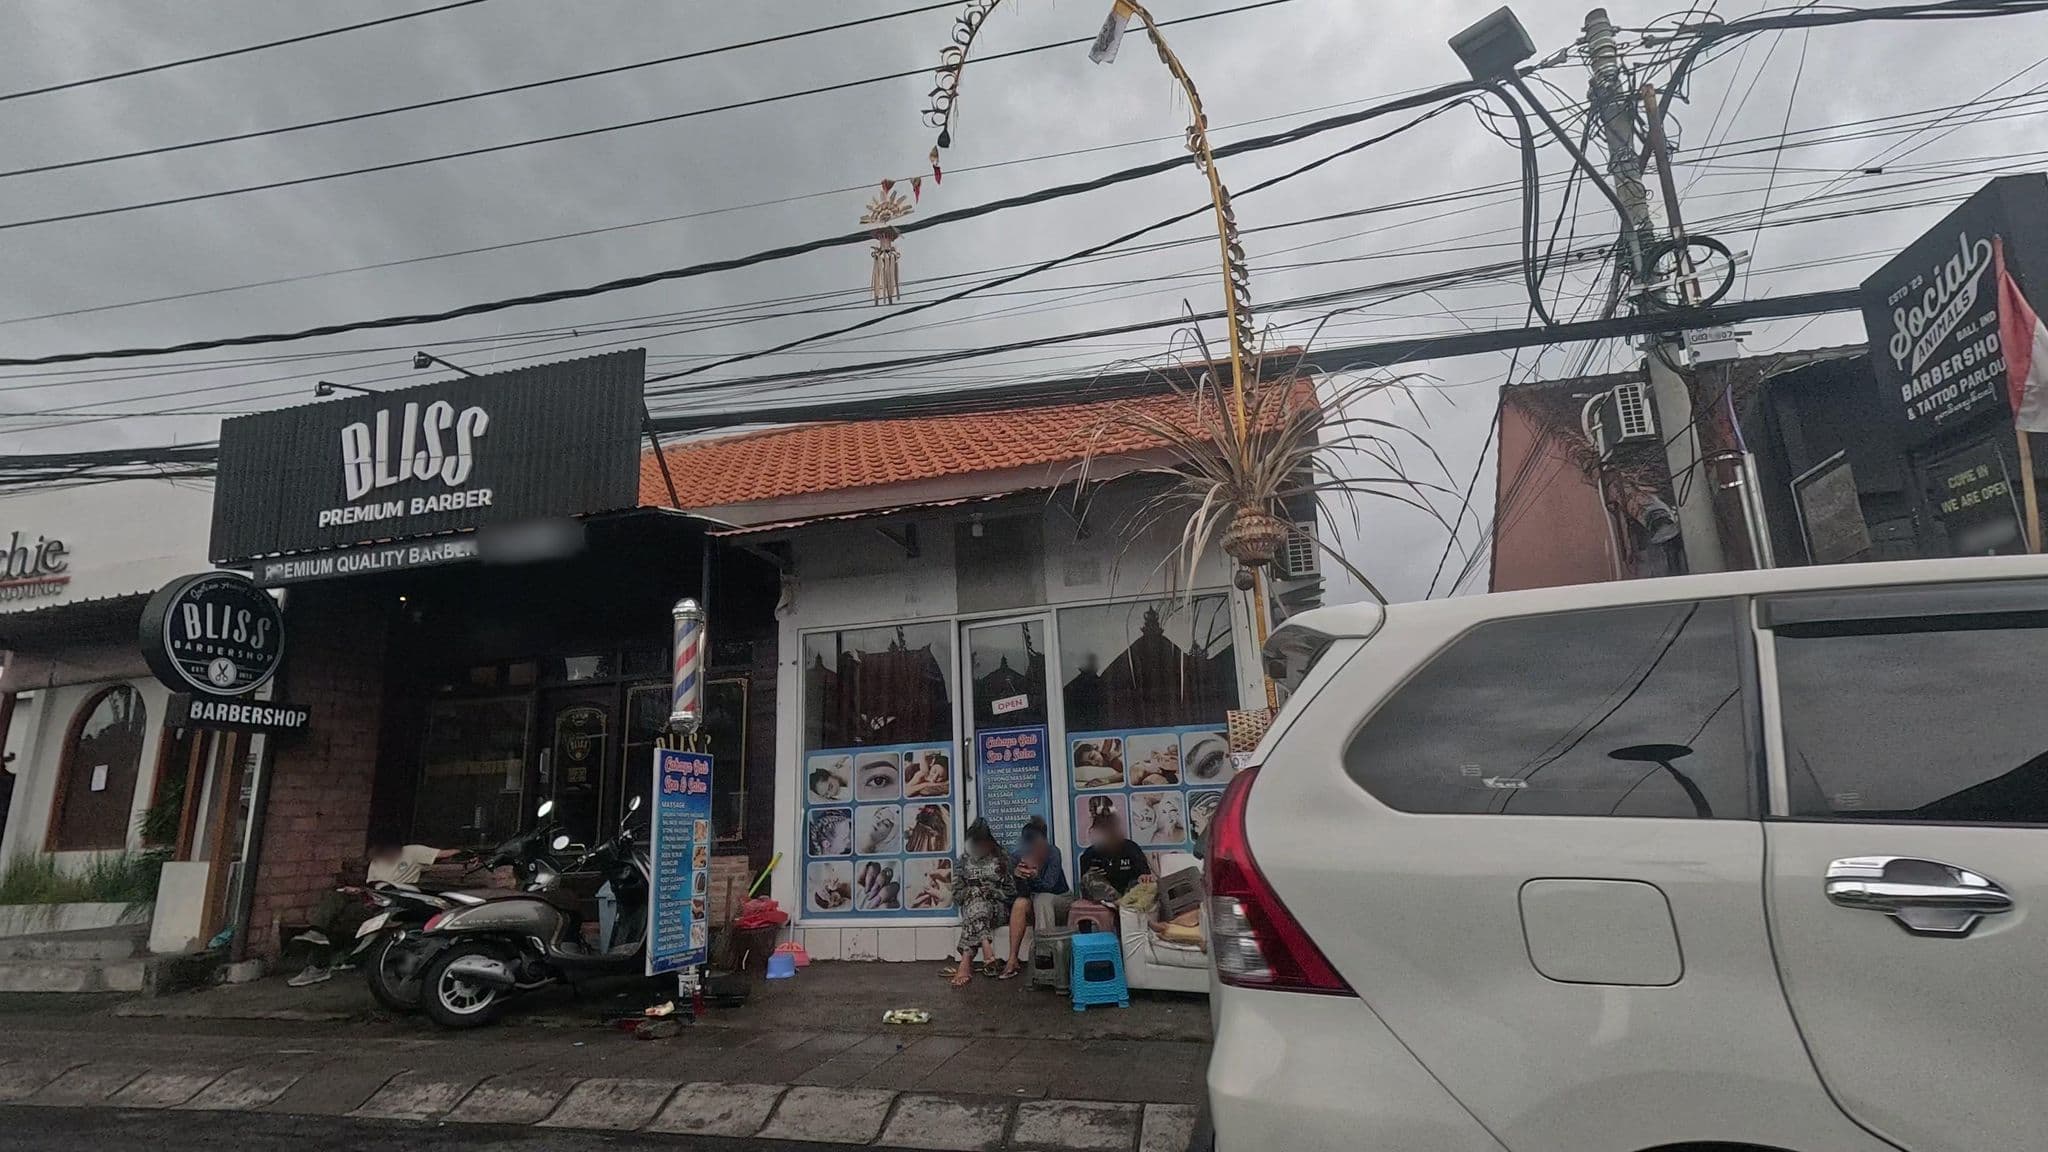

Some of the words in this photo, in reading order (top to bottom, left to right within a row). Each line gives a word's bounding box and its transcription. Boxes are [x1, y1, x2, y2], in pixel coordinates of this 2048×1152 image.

[1889, 231, 1992, 371] Social
[1917, 288, 1971, 364] ANIMALS
[1902, 329, 2003, 402] BARBERSHO
[1907, 407, 1917, 421] &
[1917, 382, 1958, 415] TATTOO
[1959, 357, 2007, 393] PARLOU
[341, 400, 489, 501] BLISS
[319, 500, 404, 528] PREMIUM
[410, 488, 493, 515] BARBER
[1941, 498, 1960, 513] WE
[1961, 490, 1981, 506] ARE
[340, 549, 405, 573] QUALITY
[182, 602, 272, 649] BLISS
[174, 640, 274, 662] BARBERSHOP
[190, 701, 308, 728] BARBERSHOP
[997, 698, 1023, 710] OPEN
